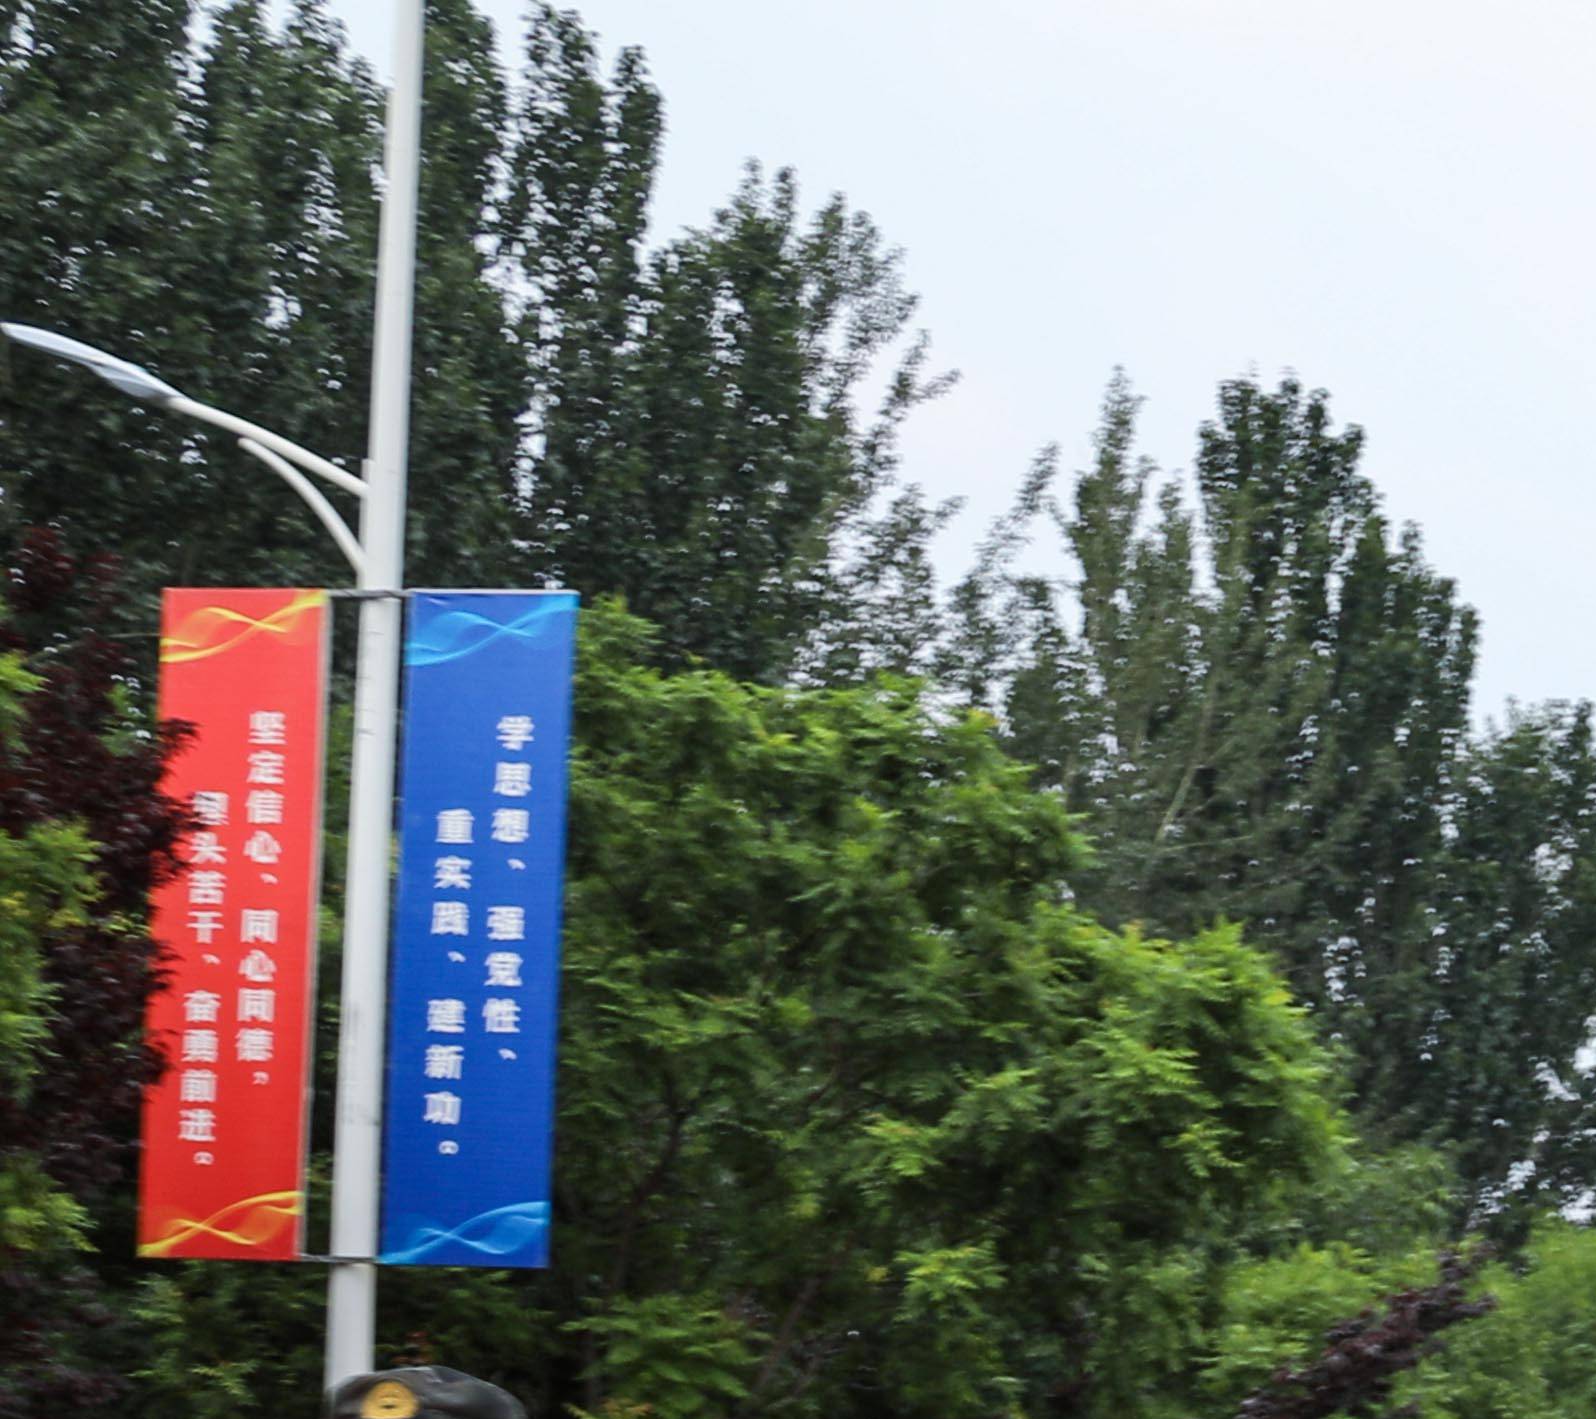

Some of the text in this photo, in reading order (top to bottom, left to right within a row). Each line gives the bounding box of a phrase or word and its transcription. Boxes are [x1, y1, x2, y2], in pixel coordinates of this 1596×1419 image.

[423, 808, 475, 1155] 重实践、建新功。
[482, 716, 535, 1061] 学思想、强党性、
